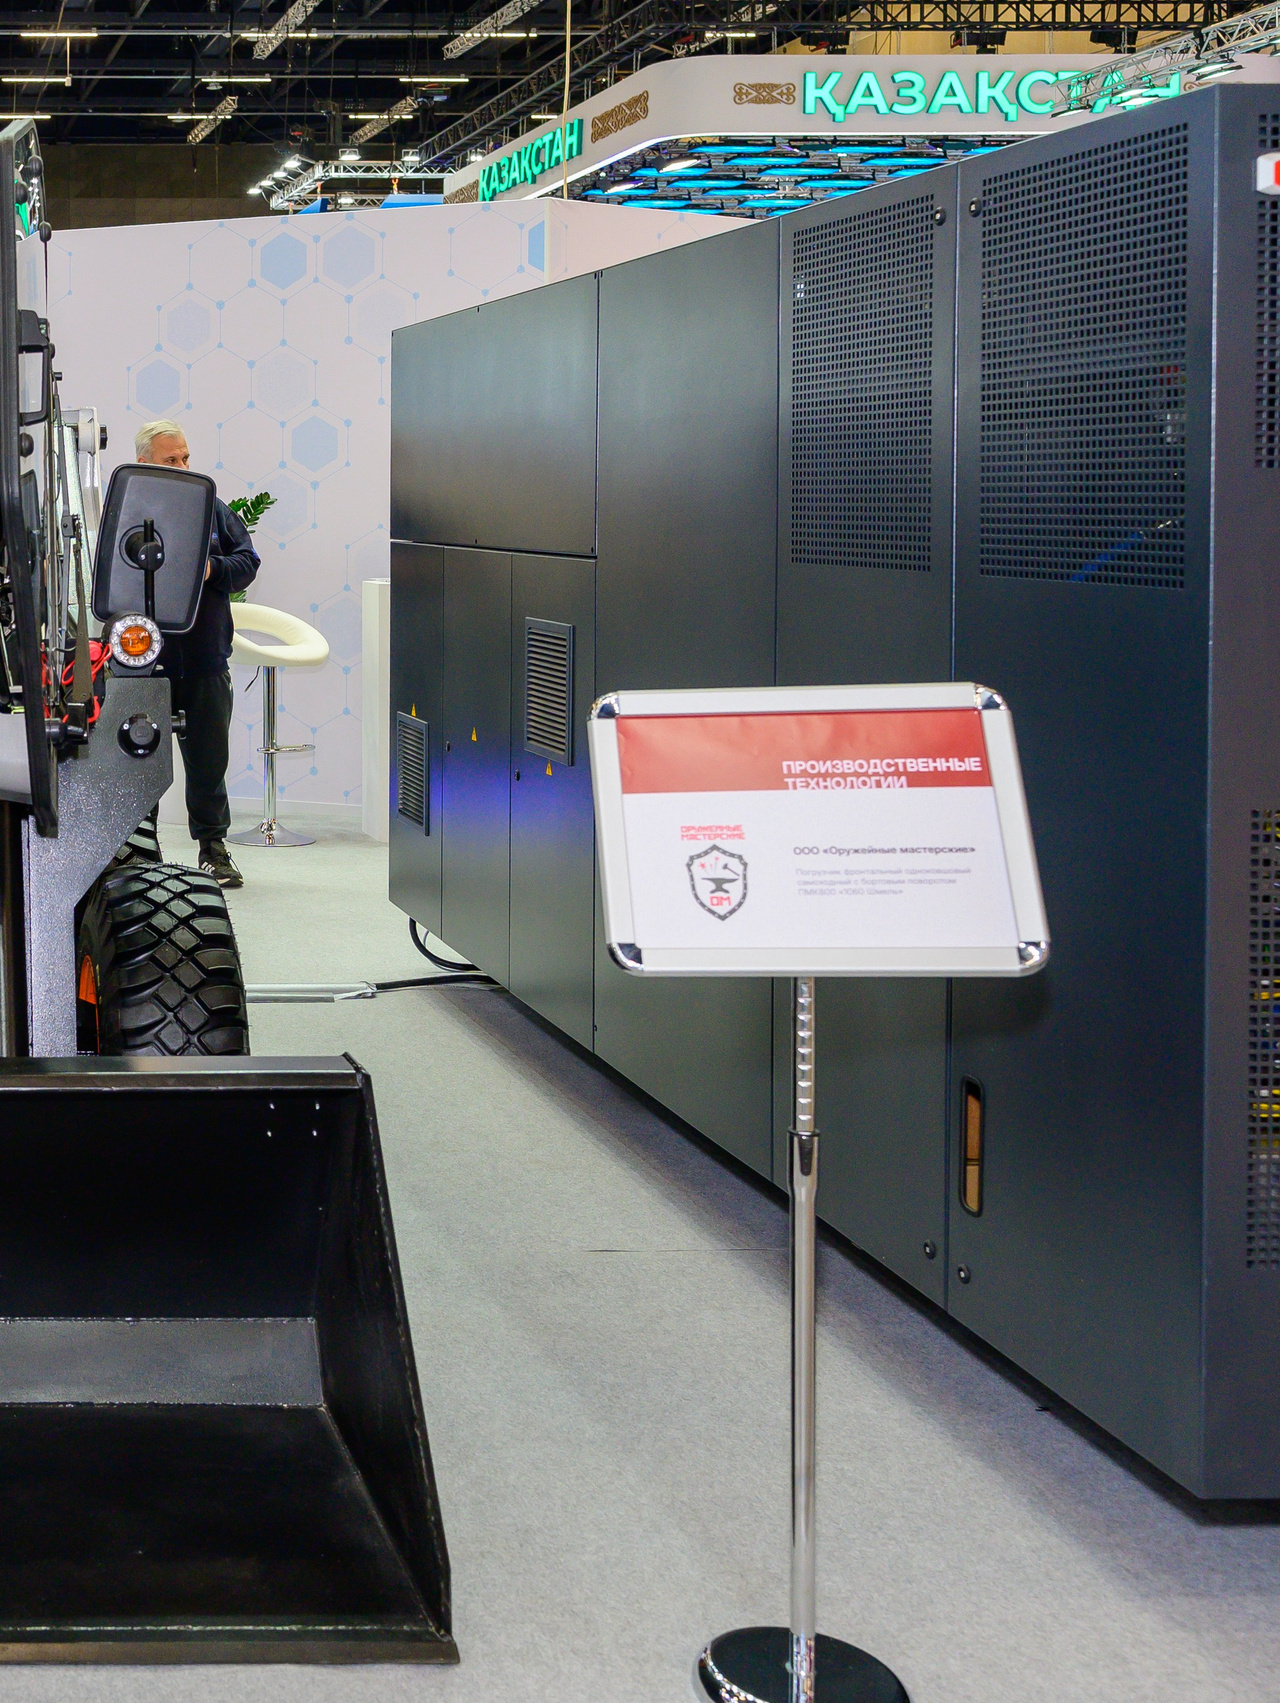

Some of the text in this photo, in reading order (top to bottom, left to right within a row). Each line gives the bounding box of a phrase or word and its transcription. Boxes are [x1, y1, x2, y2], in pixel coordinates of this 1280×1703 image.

[480, 118, 583, 202] ҚАЗАҚСТАН
[782, 757, 983, 775] ПРОИЗВОДСТВЕННЫЕ
[784, 776, 908, 790] ТЕХНОЛОГИИ
[793, 846, 976, 856] ООО «Оружейные мастерские»
